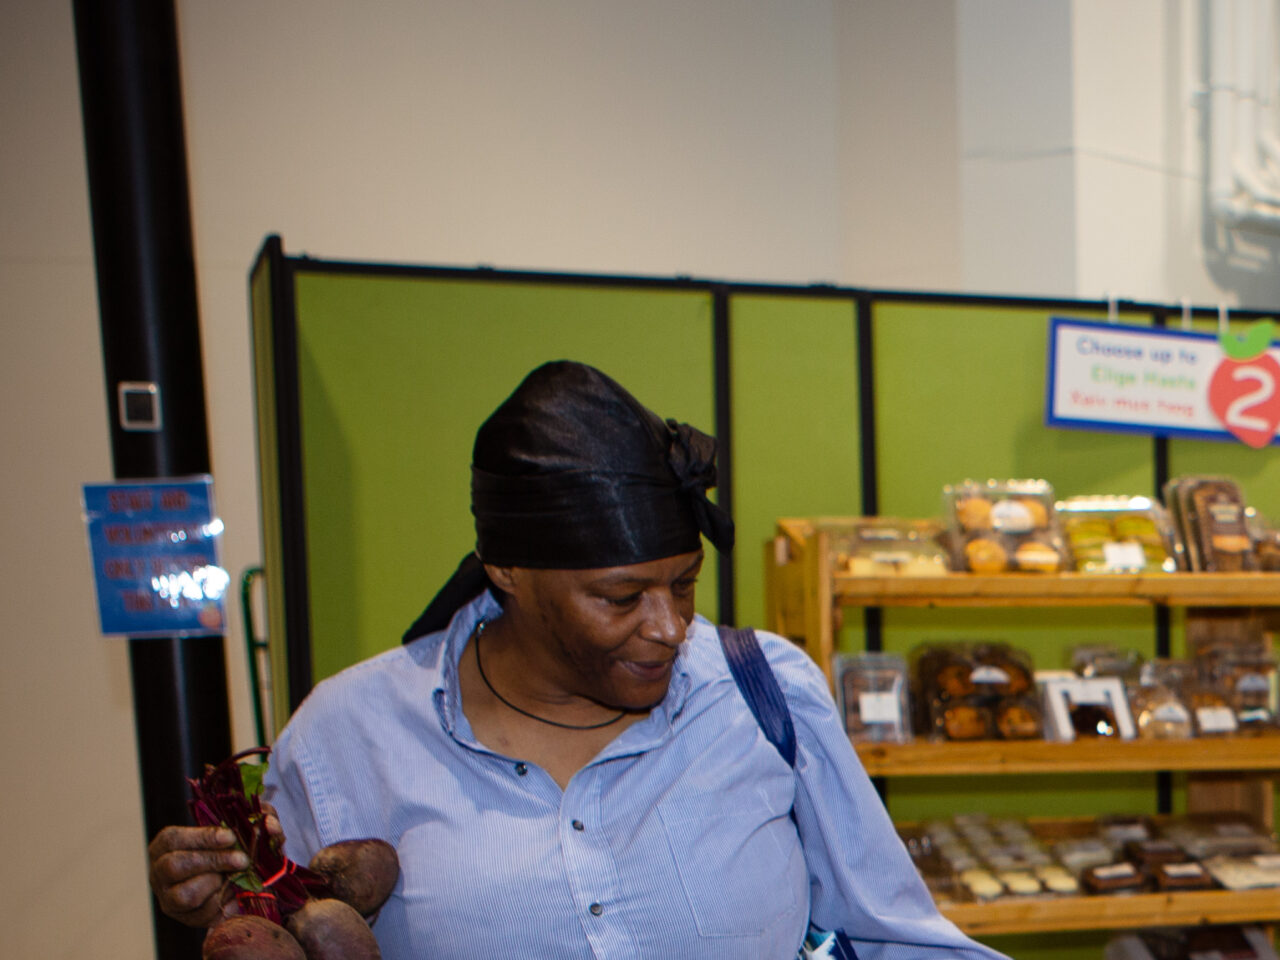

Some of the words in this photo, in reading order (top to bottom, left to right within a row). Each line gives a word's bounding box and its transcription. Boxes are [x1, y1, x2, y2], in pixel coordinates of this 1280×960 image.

[1076, 335, 1144, 360] Choose
[1150, 348, 1172, 364] up
[1178, 347, 1198, 366] to
[1224, 365, 1276, 432] 2
